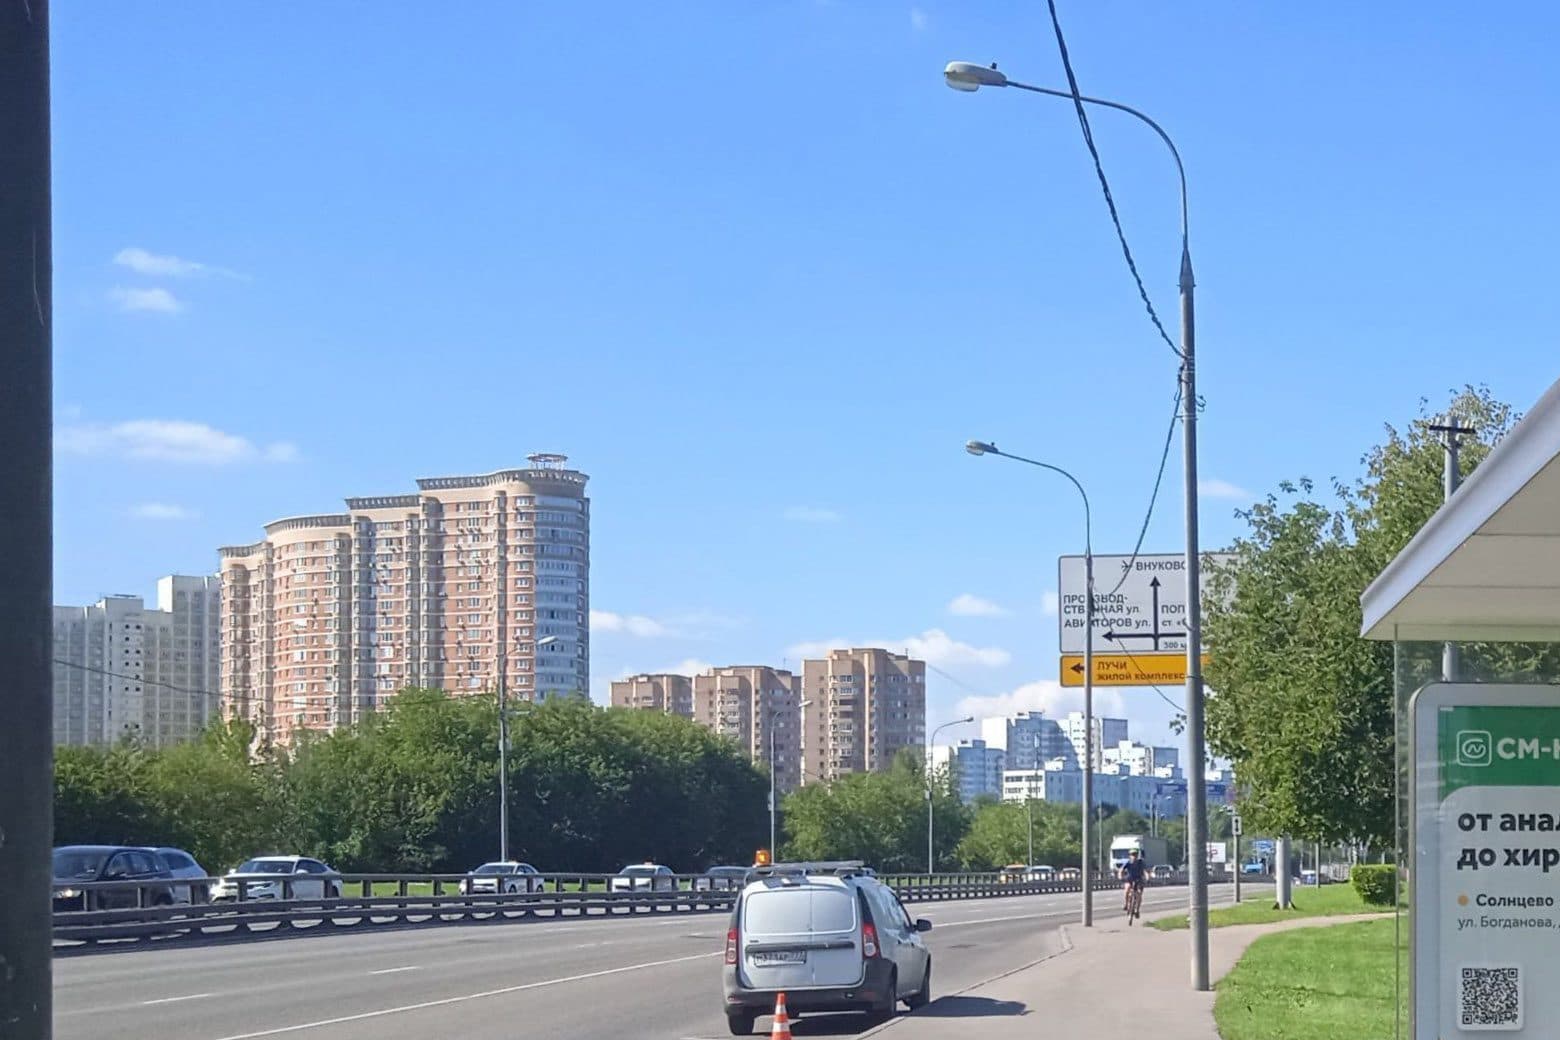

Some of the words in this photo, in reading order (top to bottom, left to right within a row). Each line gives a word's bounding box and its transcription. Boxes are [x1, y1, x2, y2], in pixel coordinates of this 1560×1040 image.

[1098, 661, 1127, 670] ЛУЧИ
[1457, 813, 1492, 832] от
[1456, 848, 1497, 870] до
[1476, 893, 1554, 909] Солнцево
[1457, 917, 1477, 930] ул.
[1480, 916, 1556, 930] Богданова,
